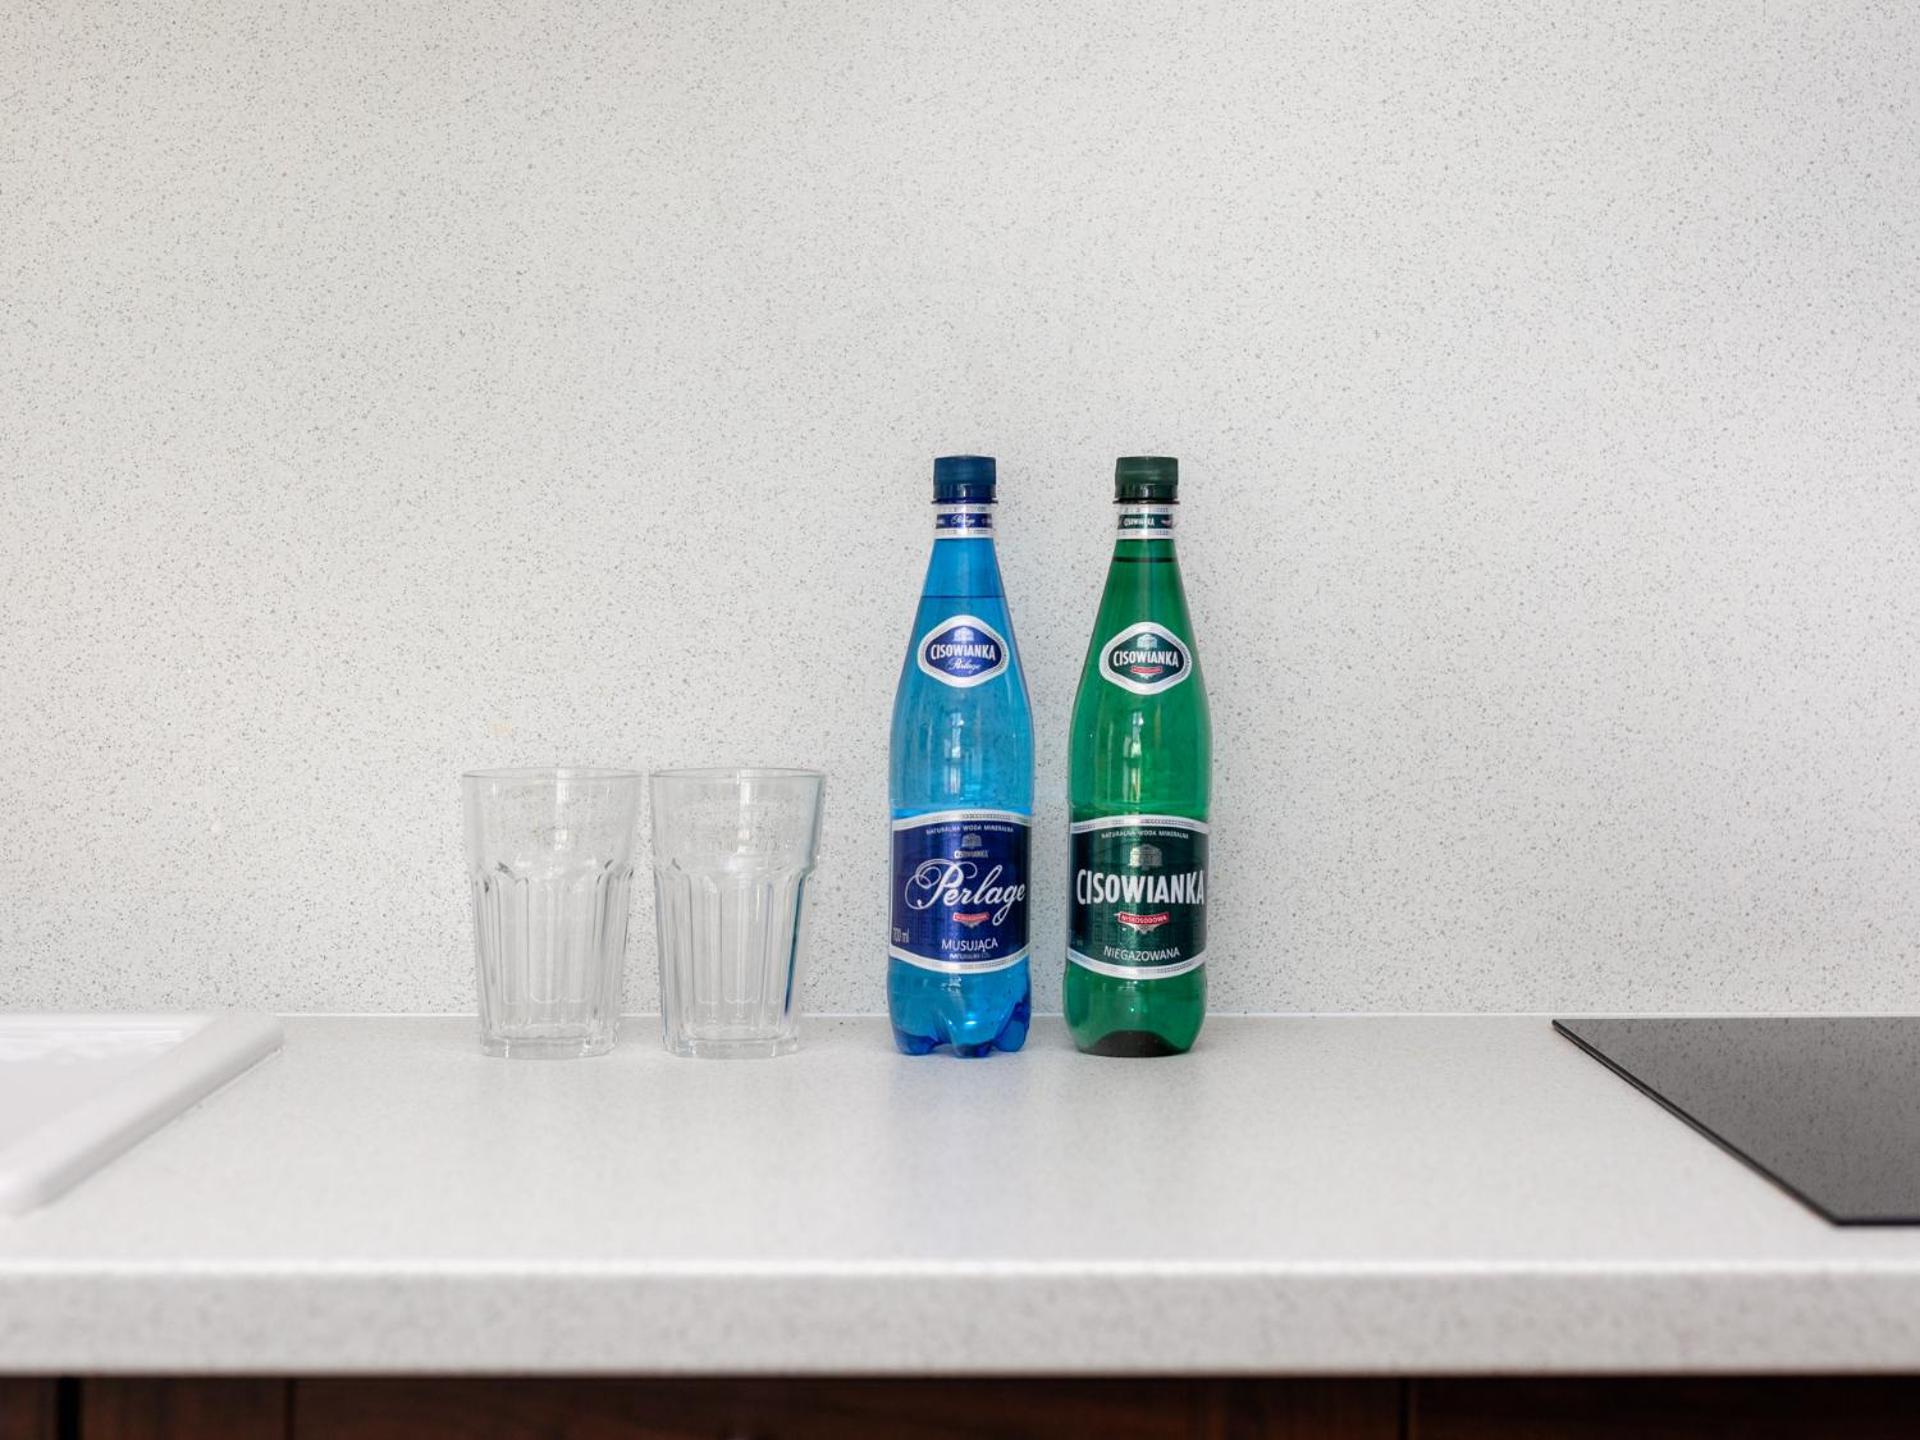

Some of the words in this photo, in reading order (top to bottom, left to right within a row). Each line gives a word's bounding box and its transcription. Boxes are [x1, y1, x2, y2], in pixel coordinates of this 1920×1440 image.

[930, 643, 996, 661] CISOWIANKA
[1113, 650, 1179, 667] CISOWIANKA
[905, 858, 1026, 926] Perlage
[1076, 868, 1205, 905] CISOWIANKA
[941, 937, 999, 952] MUSUJĄCA
[1103, 945, 1180, 961] NIEGAZOWANA
